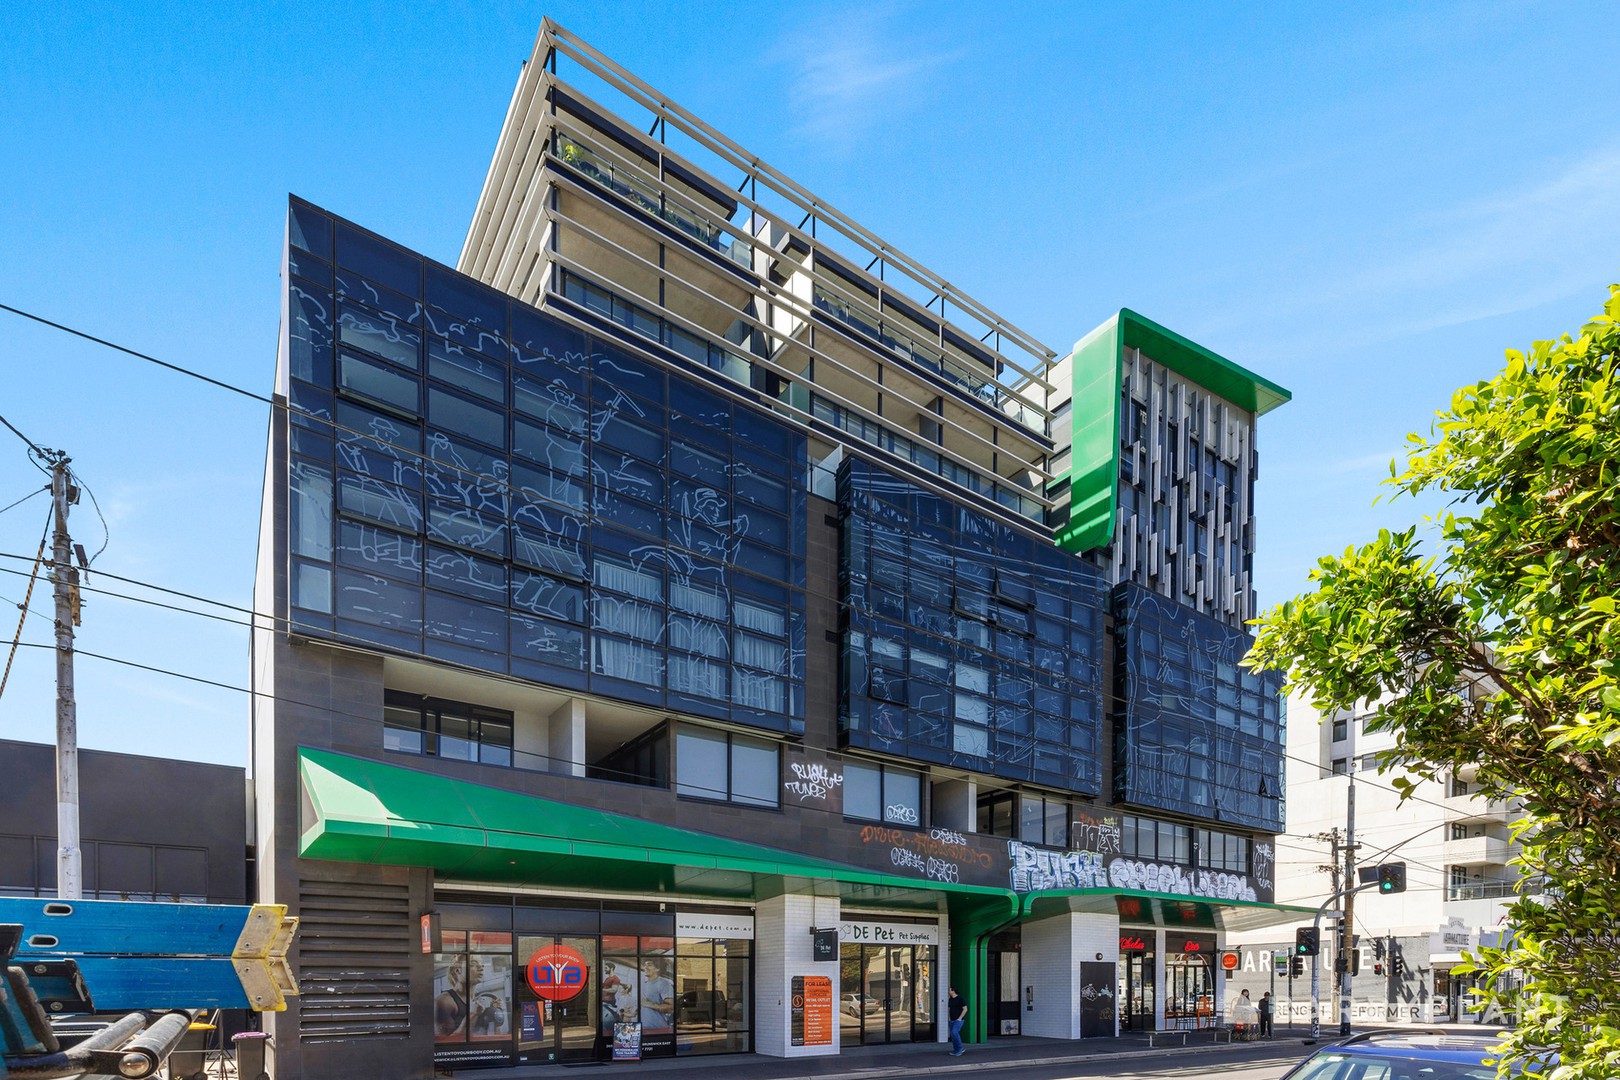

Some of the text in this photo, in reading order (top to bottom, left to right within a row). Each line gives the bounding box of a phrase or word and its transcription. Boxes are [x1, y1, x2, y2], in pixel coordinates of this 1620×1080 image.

[853, 925, 930, 943] DE Pet Pet Supplies
